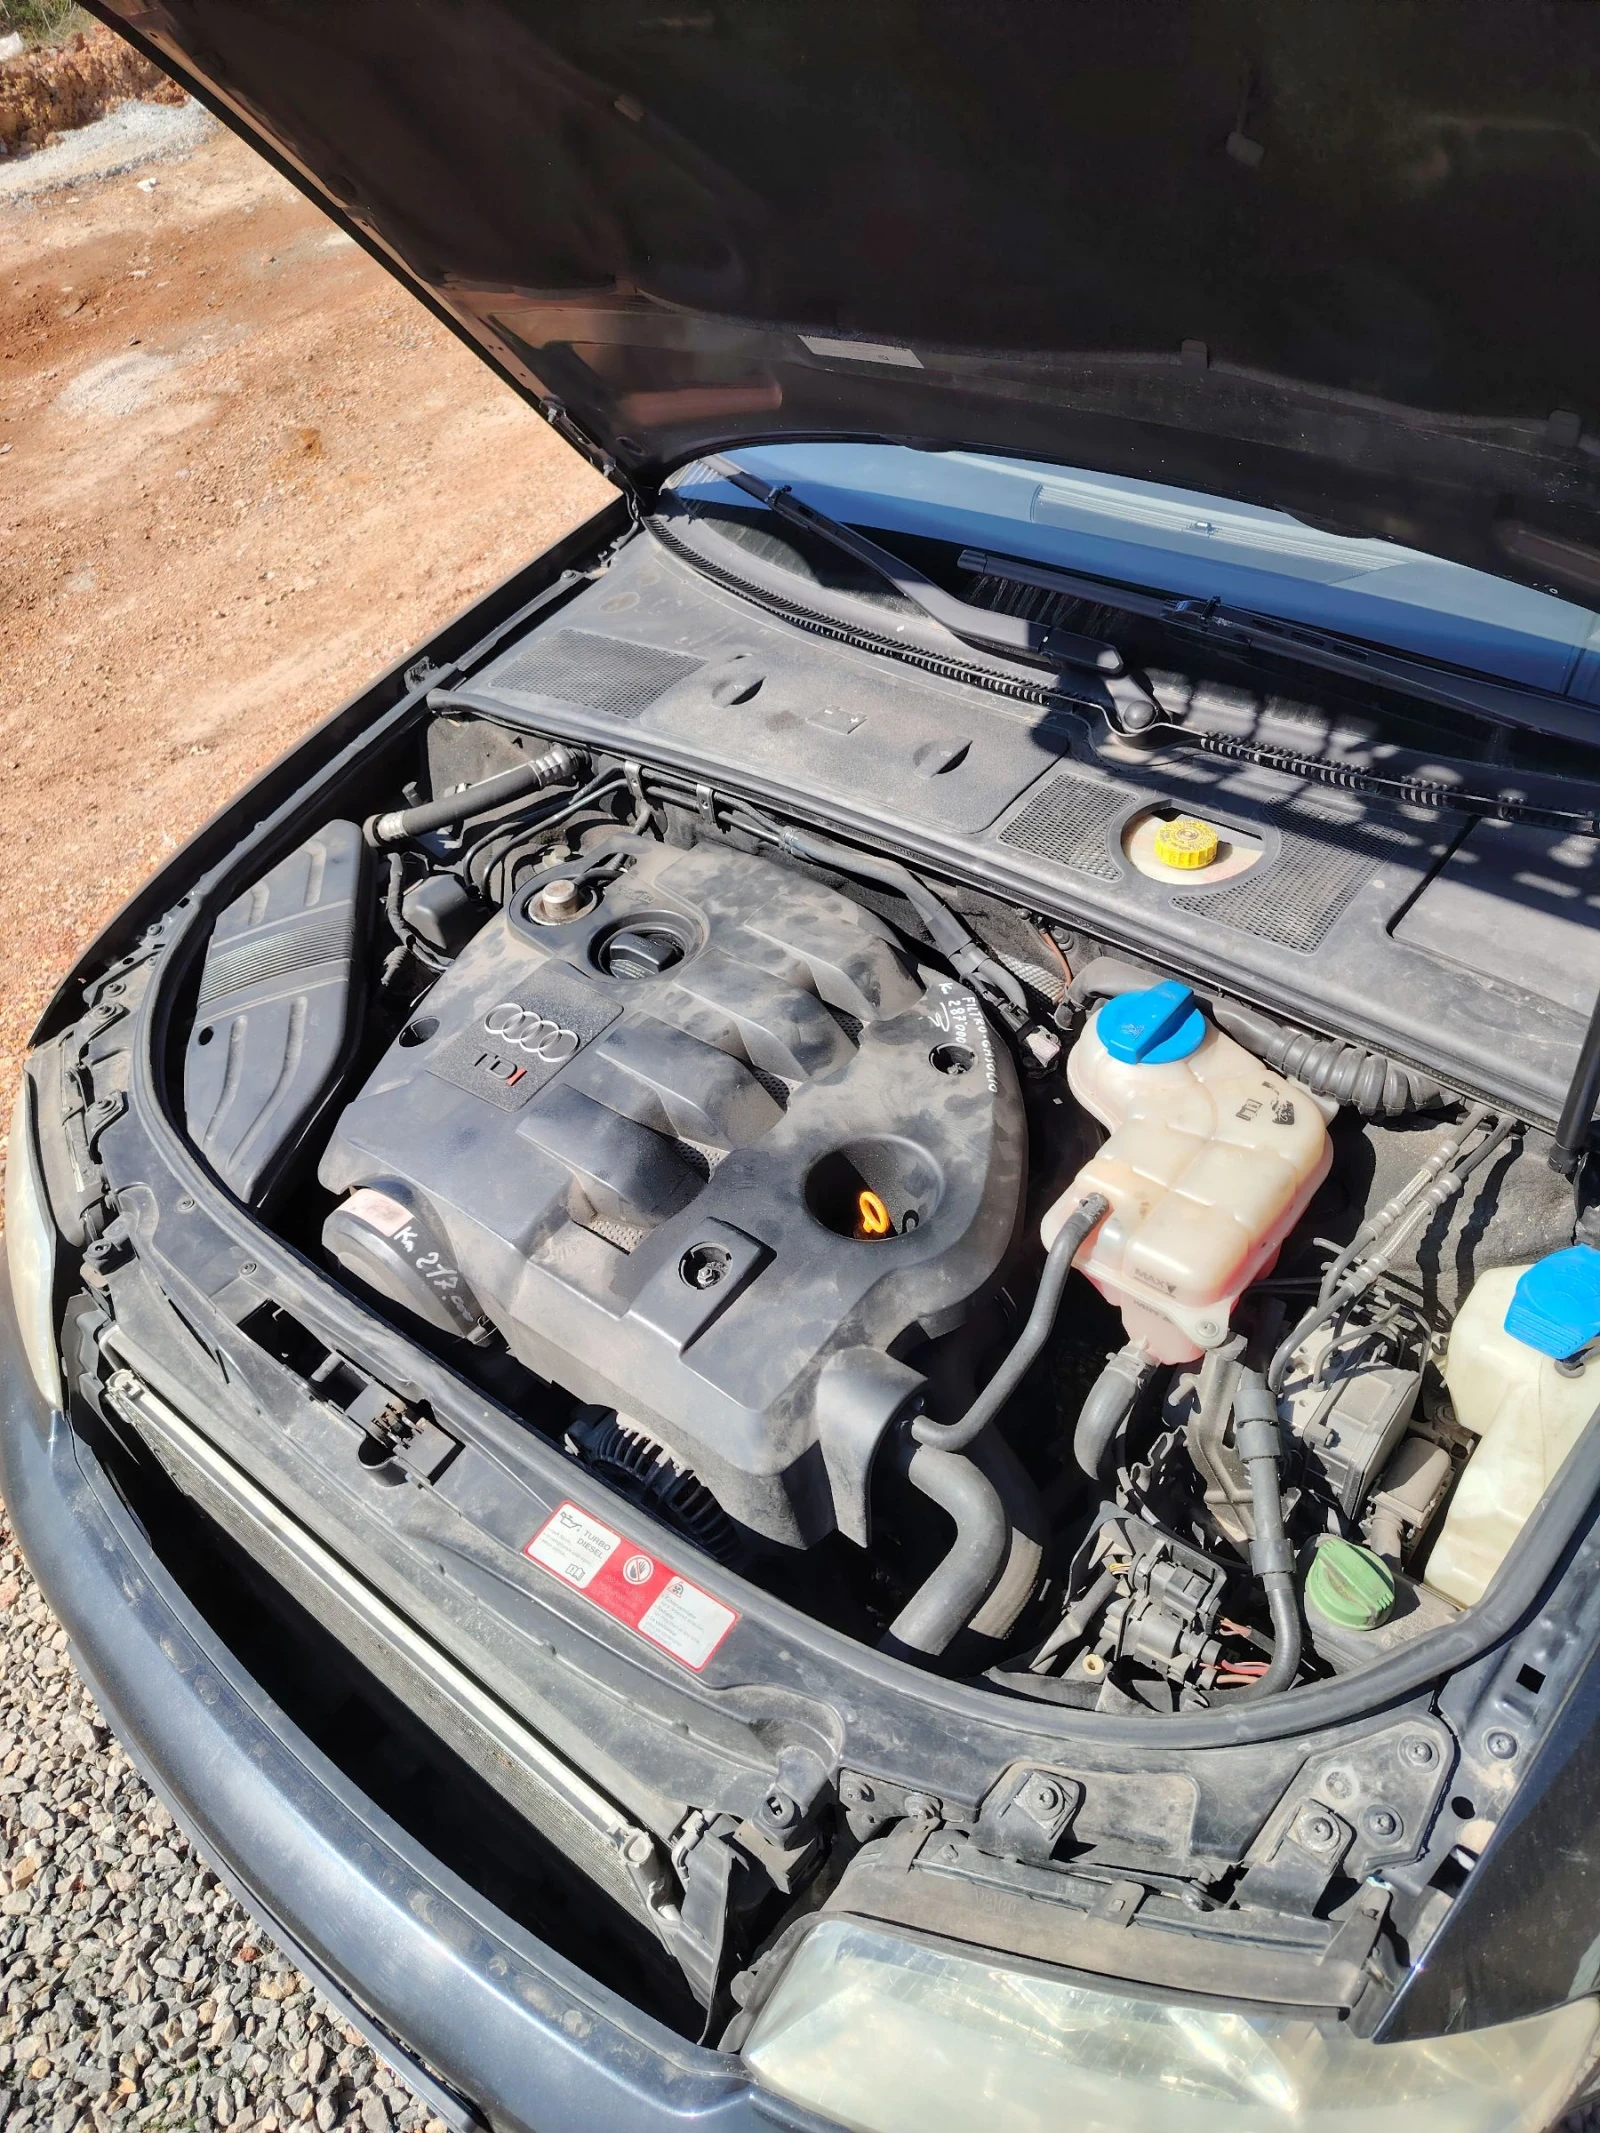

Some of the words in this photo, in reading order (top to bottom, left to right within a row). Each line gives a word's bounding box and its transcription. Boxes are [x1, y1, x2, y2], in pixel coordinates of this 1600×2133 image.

[472, 1045, 527, 1086] TDI
[576, 1537, 603, 1559] DIESEL
[583, 1529, 612, 1552] TURBO
